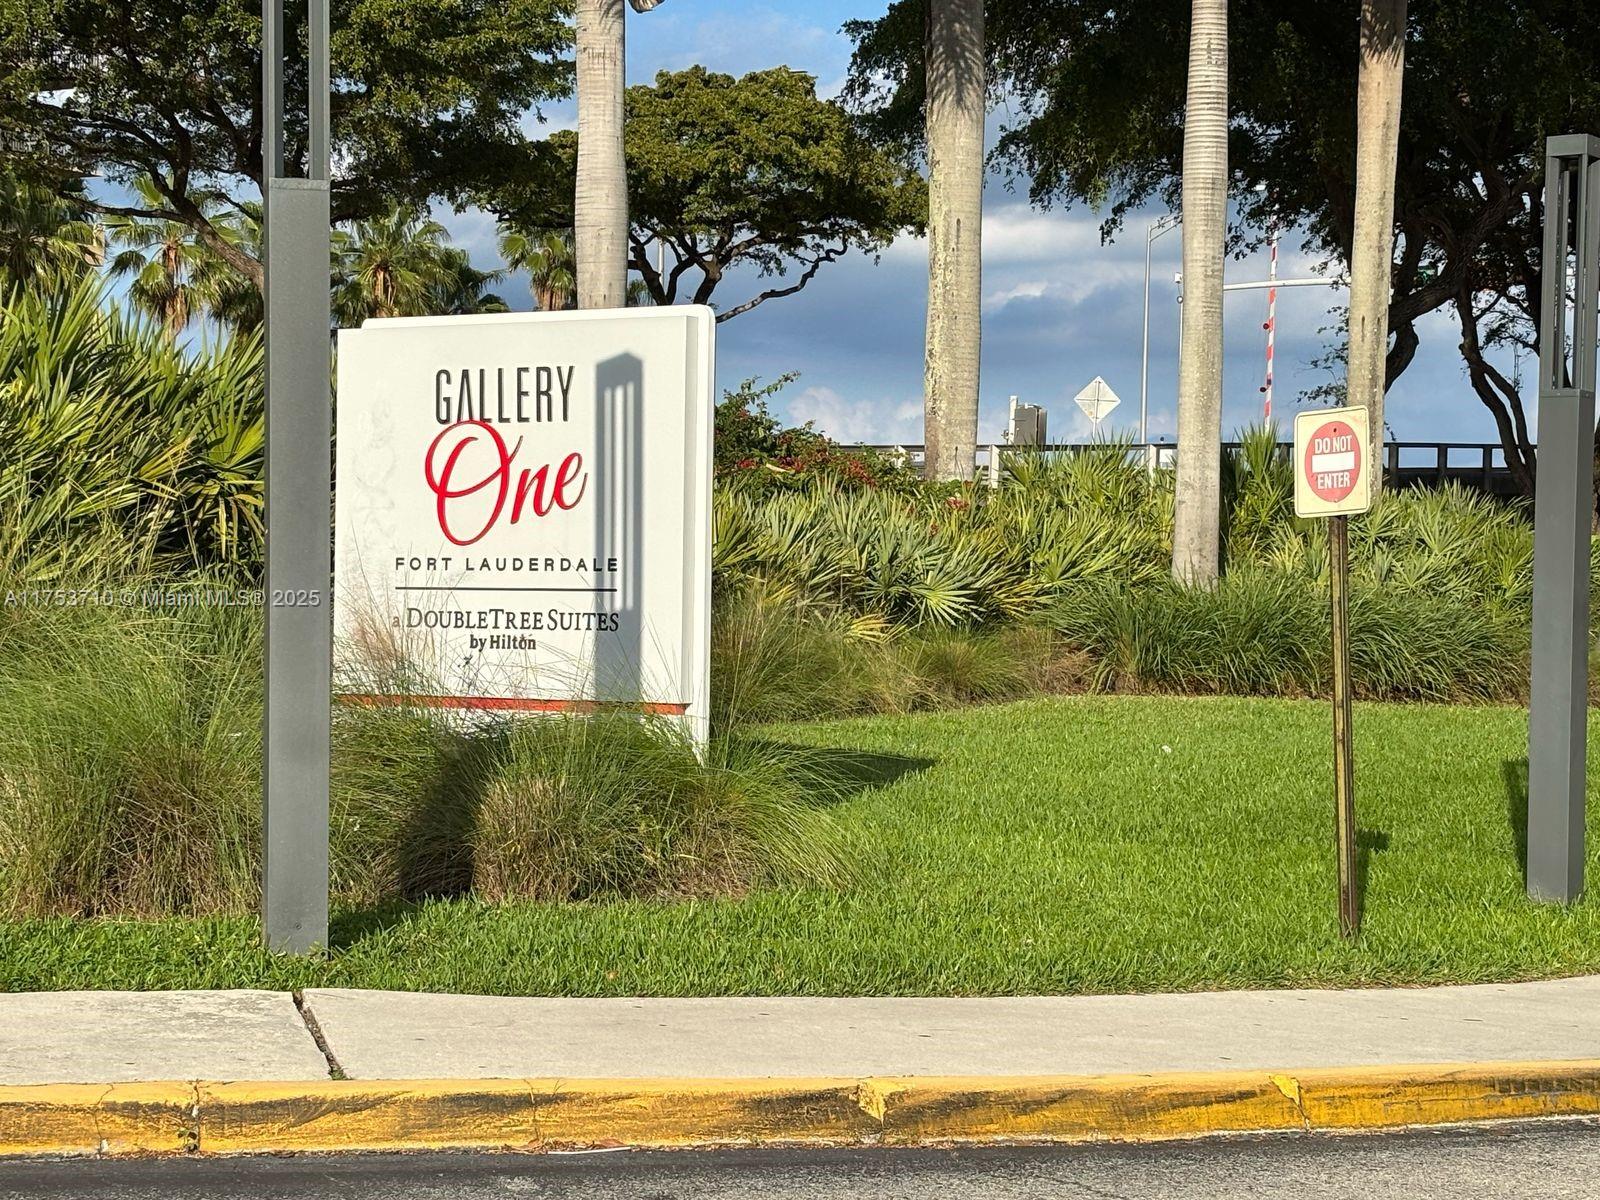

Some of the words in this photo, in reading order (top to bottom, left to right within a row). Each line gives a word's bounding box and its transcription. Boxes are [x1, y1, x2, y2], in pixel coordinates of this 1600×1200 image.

[435, 365, 576, 425] GALLERY
[1314, 437, 1330, 454] DO
[1332, 435, 1352, 452] NOT
[424, 418, 589, 547] One
[1317, 472, 1350, 489] ENTER
[395, 557, 452, 571] FORT
[466, 557, 619, 572] LAUDERDALE
[392, 616, 401, 628] a
[547, 609, 620, 632] SUITES
[469, 634, 487, 651] by
[490, 635, 537, 650] Hilton
